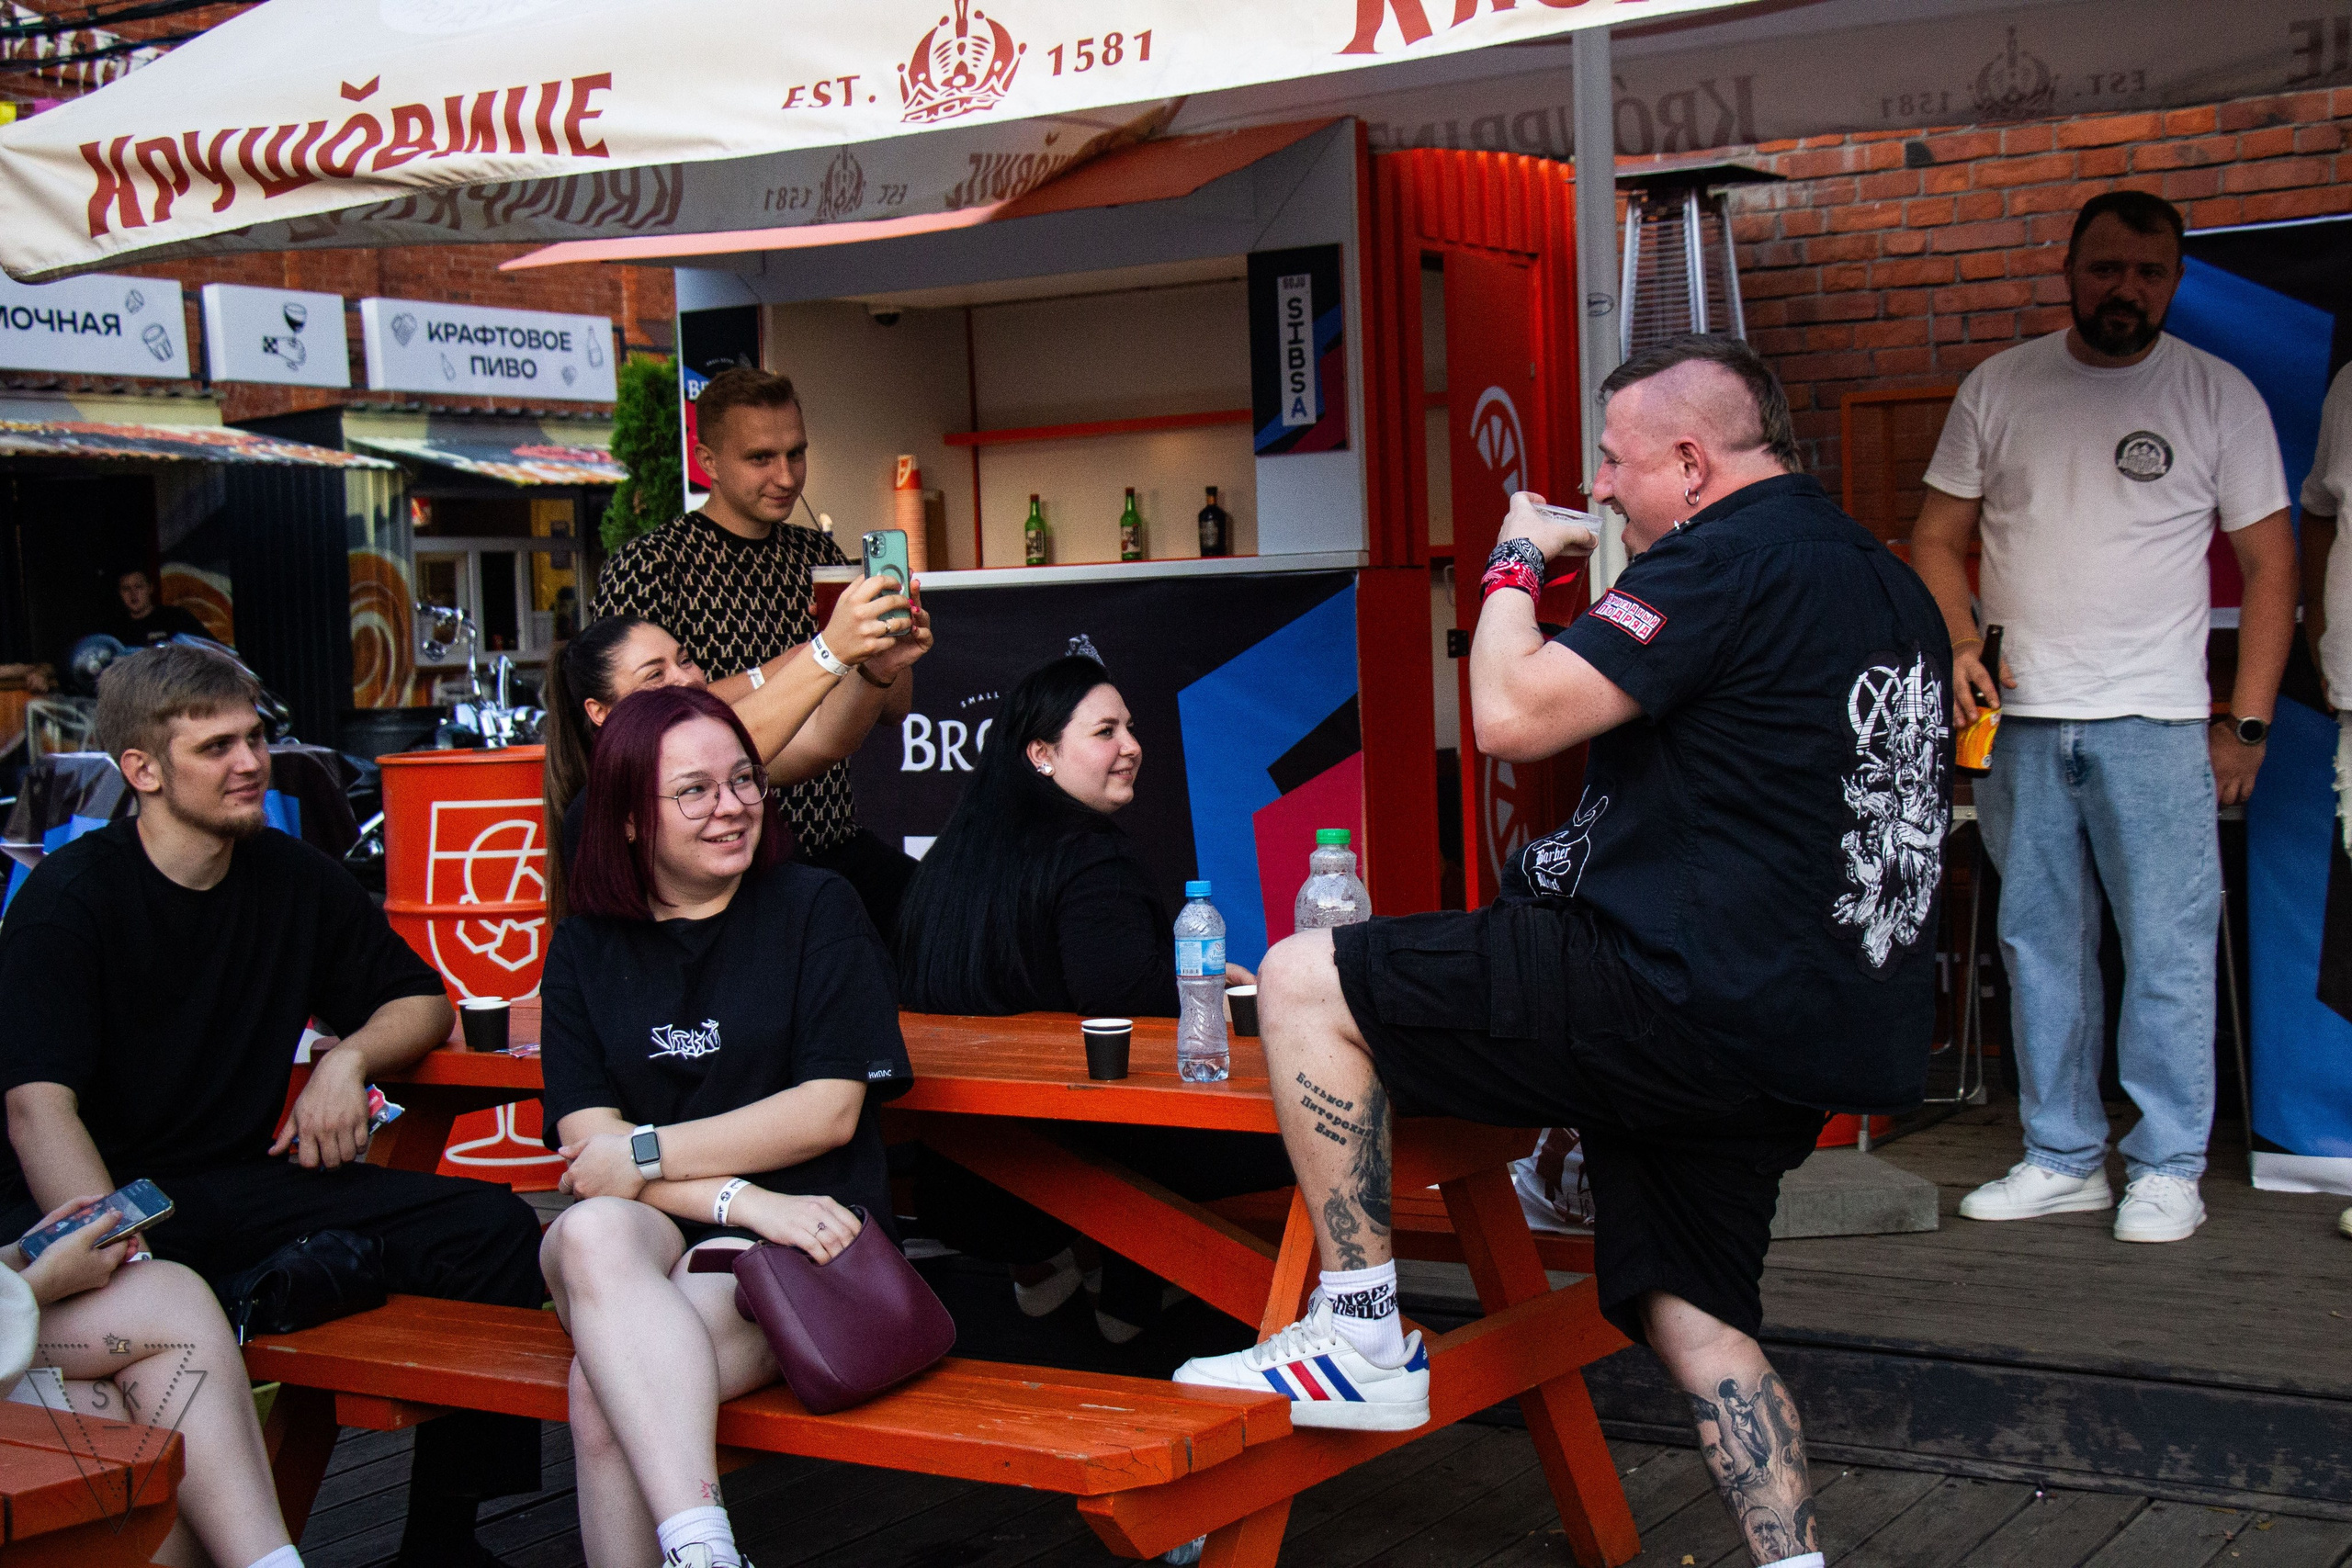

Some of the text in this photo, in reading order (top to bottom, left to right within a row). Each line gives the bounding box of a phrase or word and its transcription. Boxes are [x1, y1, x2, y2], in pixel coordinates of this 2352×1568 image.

[782, 28, 1153, 110] EST. 1581
[427, 321, 573, 352] КРАФТОВОЕ
[469, 355, 538, 379] ПИВО
[1597, 603, 1652, 638] ПОДРЯД
[1606, 592, 1660, 628] БРИГАДНЫЙ
[959, 690, 1001, 709] SMALL
[1295, 1071, 1354, 1111] Большой
